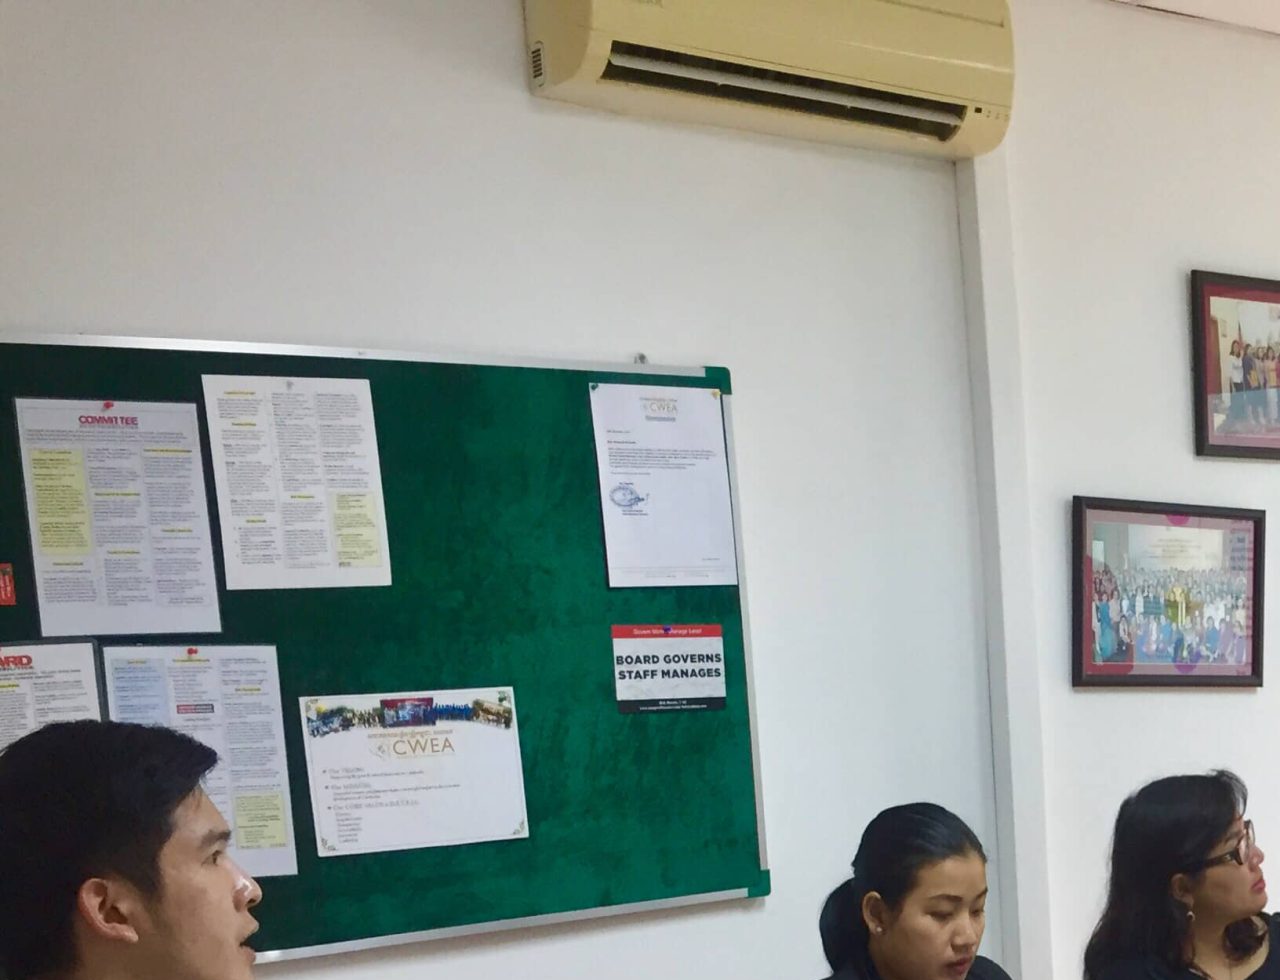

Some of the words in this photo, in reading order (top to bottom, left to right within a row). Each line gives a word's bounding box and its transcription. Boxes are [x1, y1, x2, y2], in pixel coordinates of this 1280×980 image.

[78, 415, 139, 426] COMMITTEE
[616, 655, 660, 665] BOARD
[663, 653, 722, 664] GOVERNS
[618, 670, 658, 680] STAFF
[661, 668, 722, 679] MANAGES
[392, 738, 455, 755] CWEA
